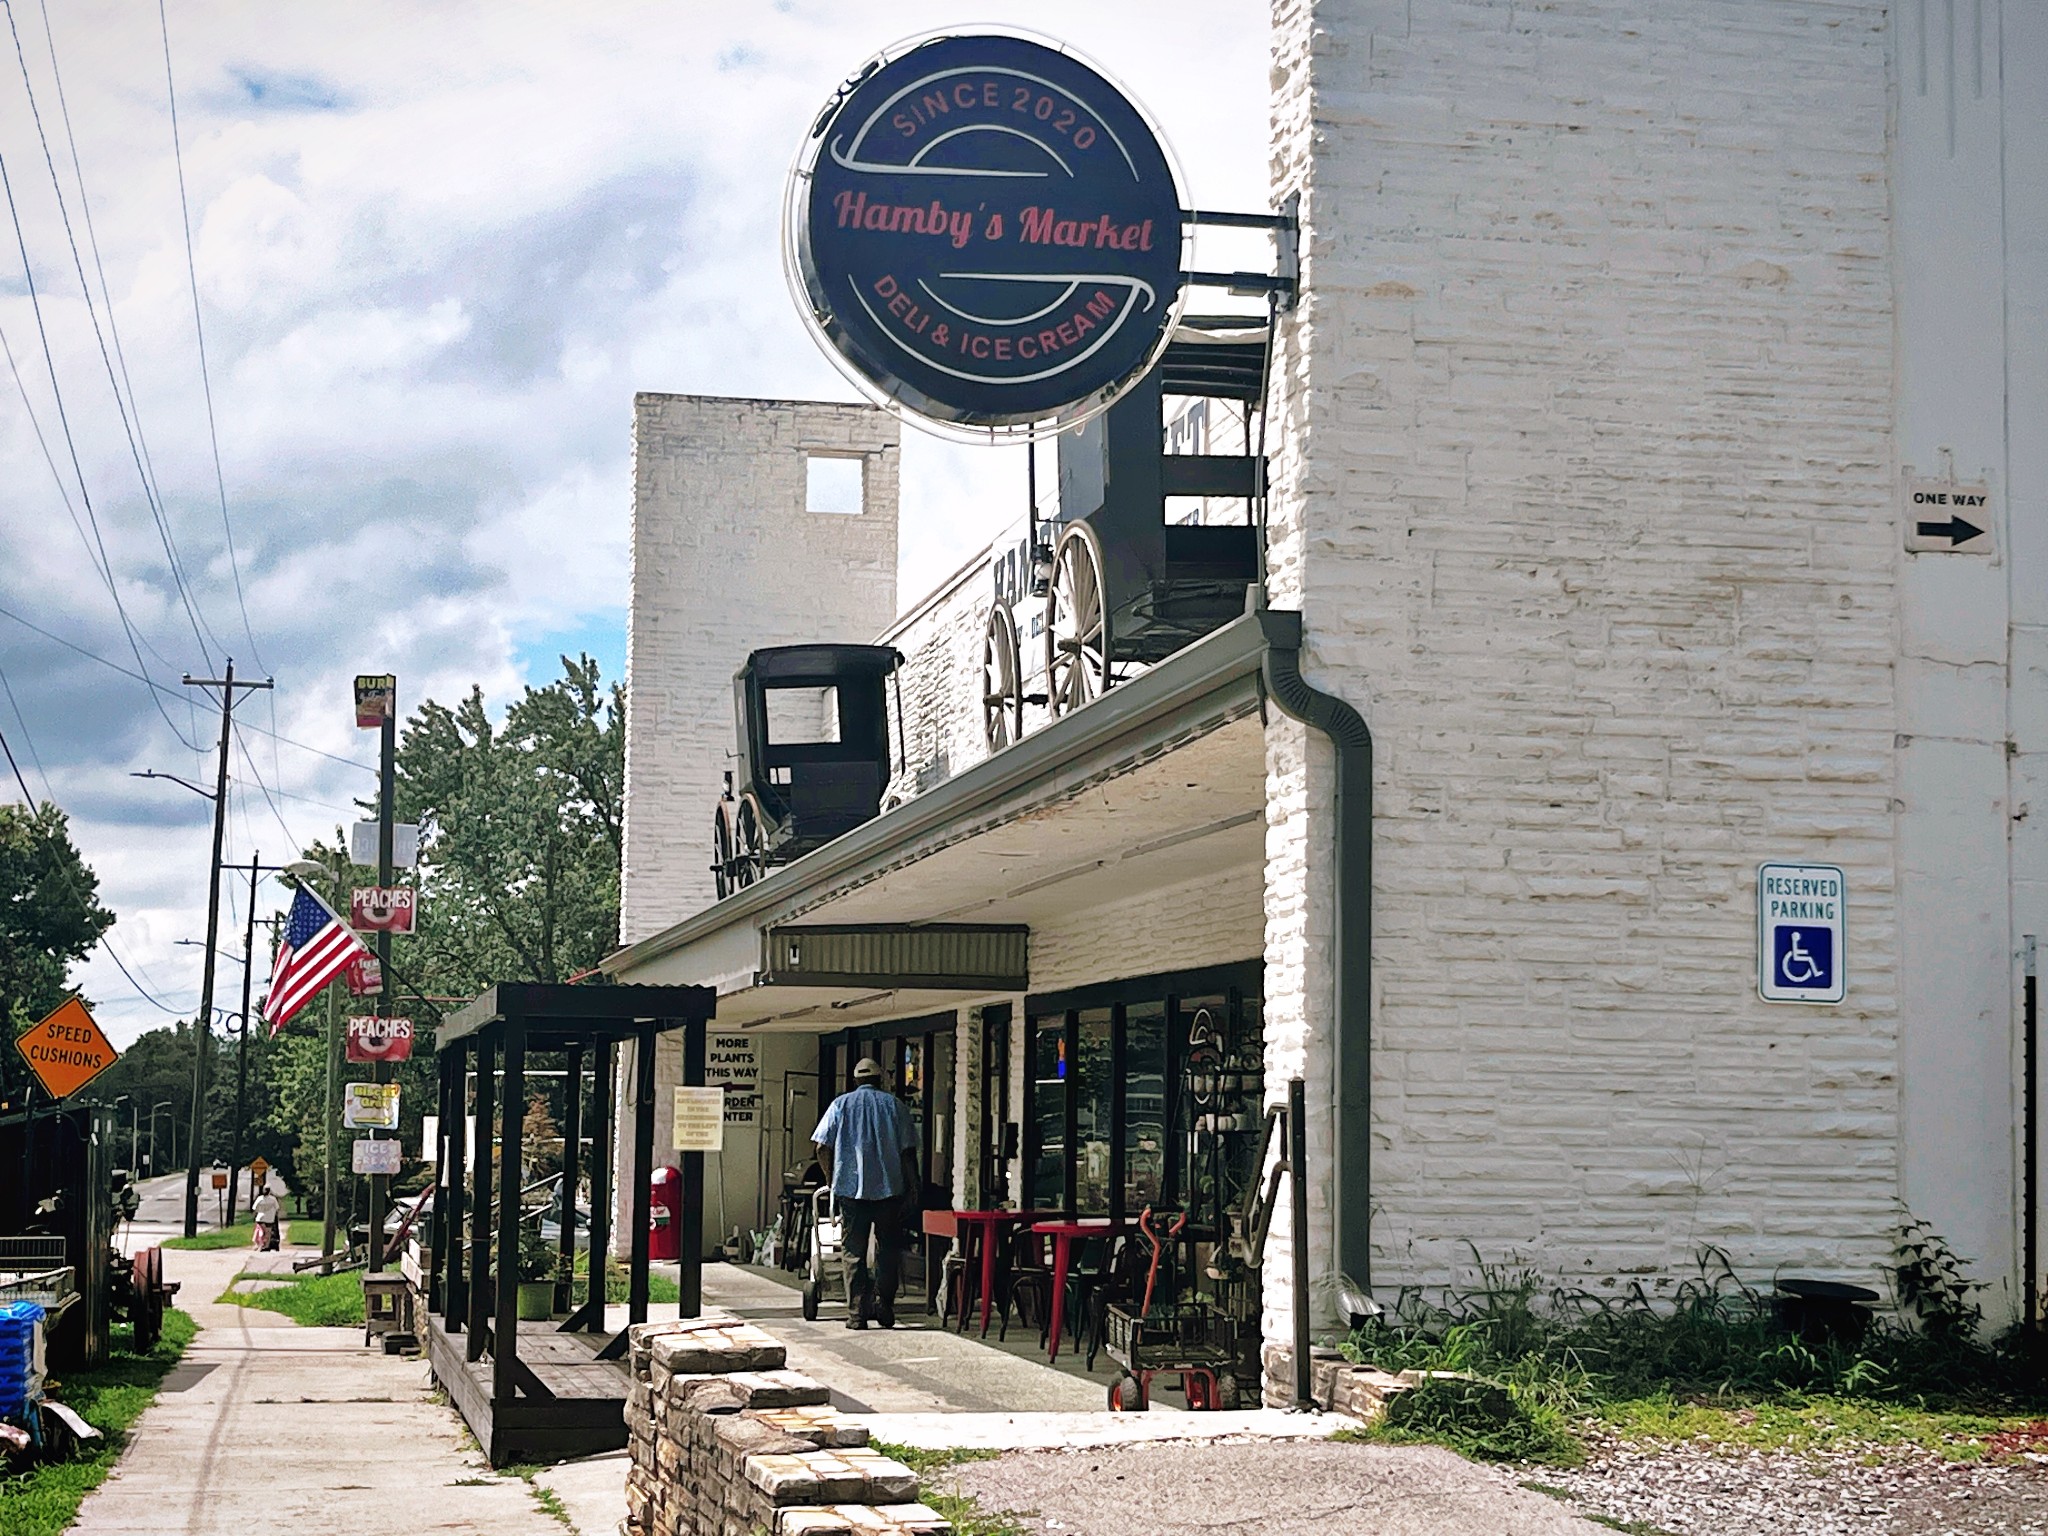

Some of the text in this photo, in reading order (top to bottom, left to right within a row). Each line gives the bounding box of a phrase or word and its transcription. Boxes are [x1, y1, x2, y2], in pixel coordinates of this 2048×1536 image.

[893, 83, 1096, 150] SINCE 2020
[833, 190, 1154, 251] Hamby's Market
[874, 275, 927, 334] DELI
[931, 324, 950, 346] &
[1913, 492, 1986, 507] ONE WAY
[1766, 877, 1837, 897] RESERVED
[353, 889, 411, 908] PEACHES
[1771, 901, 1834, 919] PARKING
[47, 1024, 92, 1044] SPEED
[349, 1018, 410, 1038] PEACHES
[716, 1038, 749, 1048] MORE
[30, 1045, 102, 1069] CUSHIONS
[710, 1053, 755, 1063] PLANTS
[705, 1068, 759, 1078] THIS WAY
[724, 1097, 755, 1107] RDEN
[724, 1112, 753, 1122] NTER
[365, 1143, 388, 1154] ICE
[354, 1156, 400, 1165] CREAM
